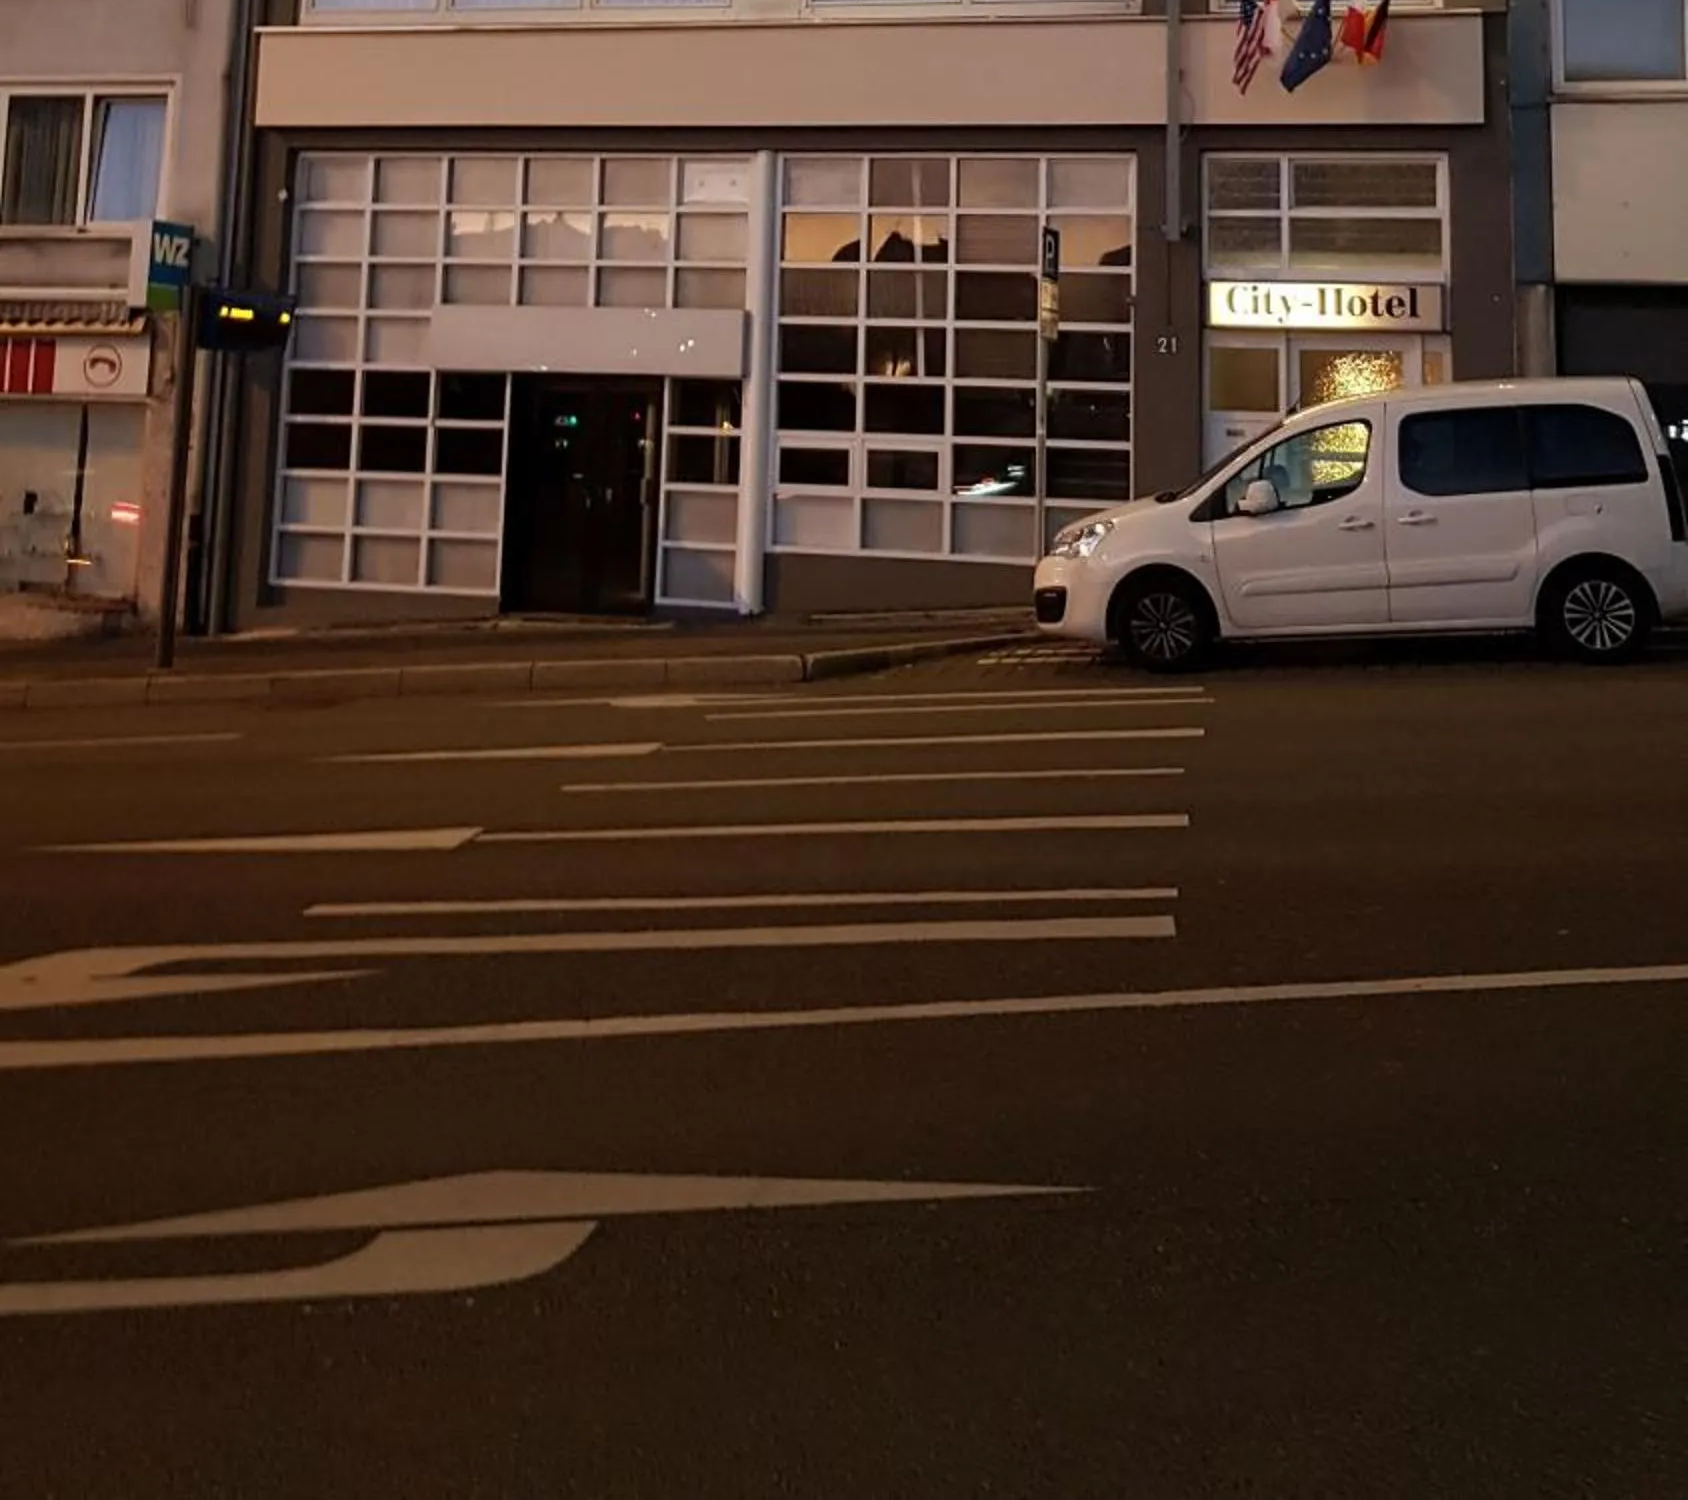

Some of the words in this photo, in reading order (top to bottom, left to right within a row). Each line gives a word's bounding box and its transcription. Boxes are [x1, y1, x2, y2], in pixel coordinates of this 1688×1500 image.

[153, 232, 190, 267] WZ
[1045, 233, 1056, 271] P
[1226, 285, 1420, 324] City-Hotel
[1157, 337, 1178, 353] 21
